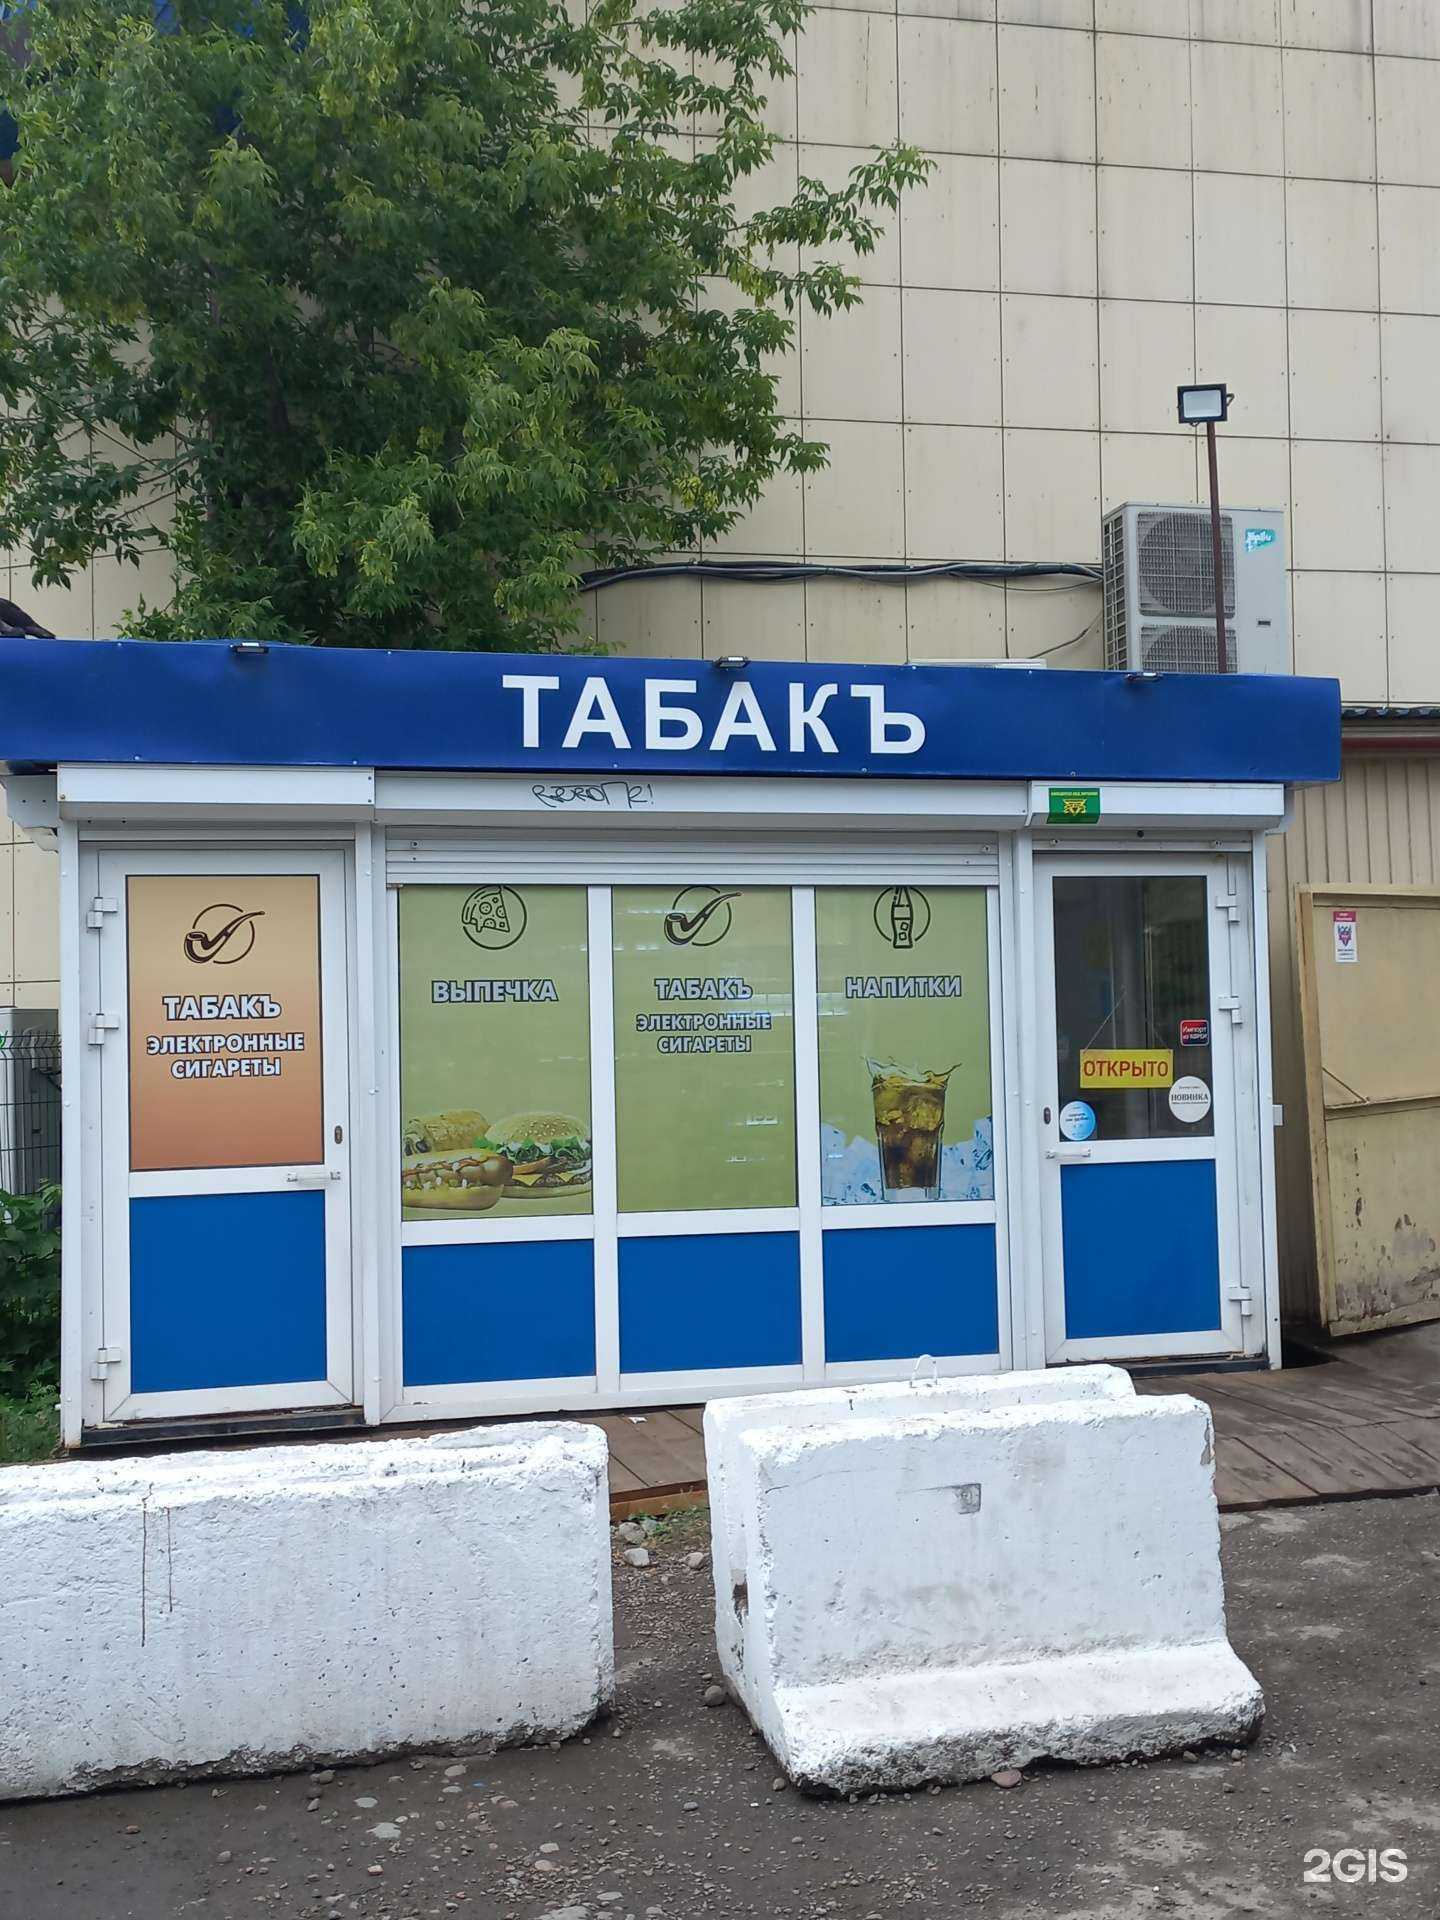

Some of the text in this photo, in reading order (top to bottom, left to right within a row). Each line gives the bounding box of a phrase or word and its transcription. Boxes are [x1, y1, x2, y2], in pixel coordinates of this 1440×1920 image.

[502, 674, 926, 755] ТАБАКЪ
[431, 979, 559, 1003] ВЫПЕЧКА
[654, 977, 753, 1001] ТАБАКЪ
[845, 975, 962, 999] НАПИТКИ
[162, 994, 282, 1021] ТАБАКЪ
[636, 1012, 772, 1032] ЭЛЕКТРОННЫЕ
[146, 1032, 305, 1055] ЭЛЕКТРОННЫЕ
[657, 1035, 752, 1054] СИГАРЕТЫ
[171, 1057, 282, 1079] СИГАРЕТЫ
[1083, 1060, 1169, 1078] ОТКРЫТО
[1171, 1092, 1209, 1102] НОВИНКА
